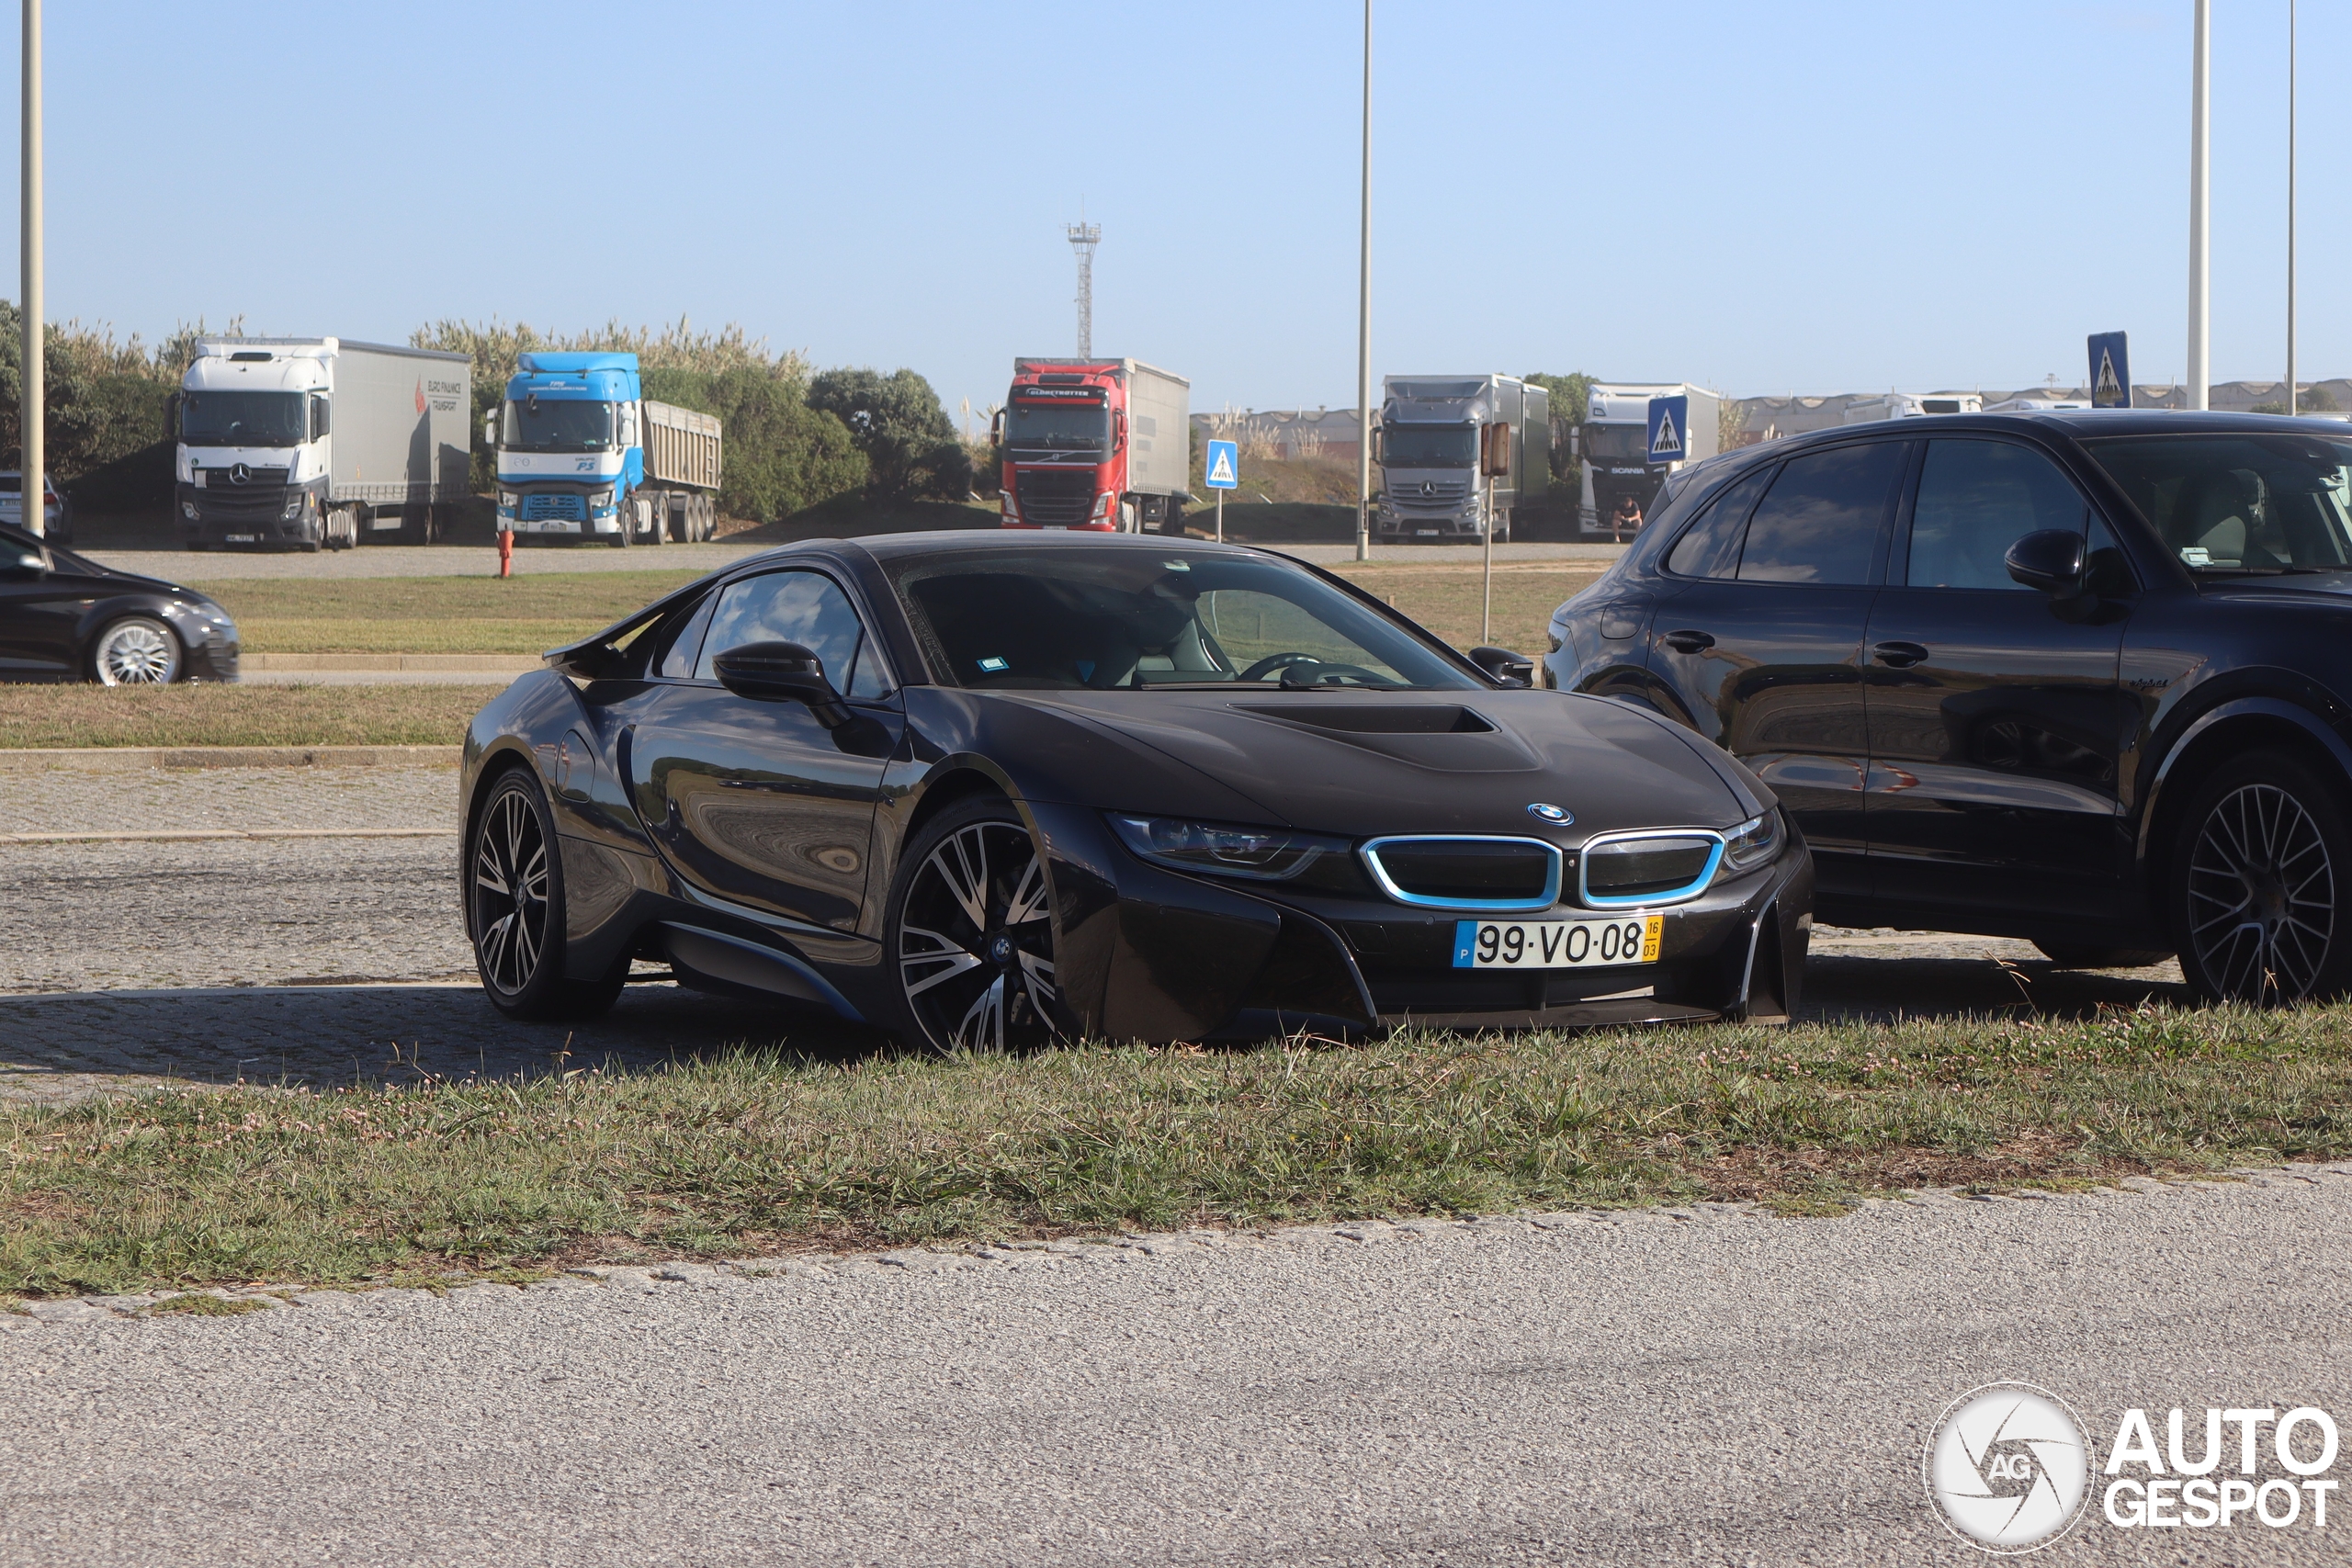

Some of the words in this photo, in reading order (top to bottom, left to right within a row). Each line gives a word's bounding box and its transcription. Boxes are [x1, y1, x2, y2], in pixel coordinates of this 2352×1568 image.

[428, 380, 440, 392] EURO
[441, 381, 461, 394] FINANCE
[1028, 389, 1089, 397] GLOBETROTTER
[433, 400, 457, 412] TRANSPORT
[576, 462, 595, 471] PS
[1649, 921, 1659, 934] 16
[1460, 949, 1469, 960] P
[1643, 944, 1657, 956] 03
